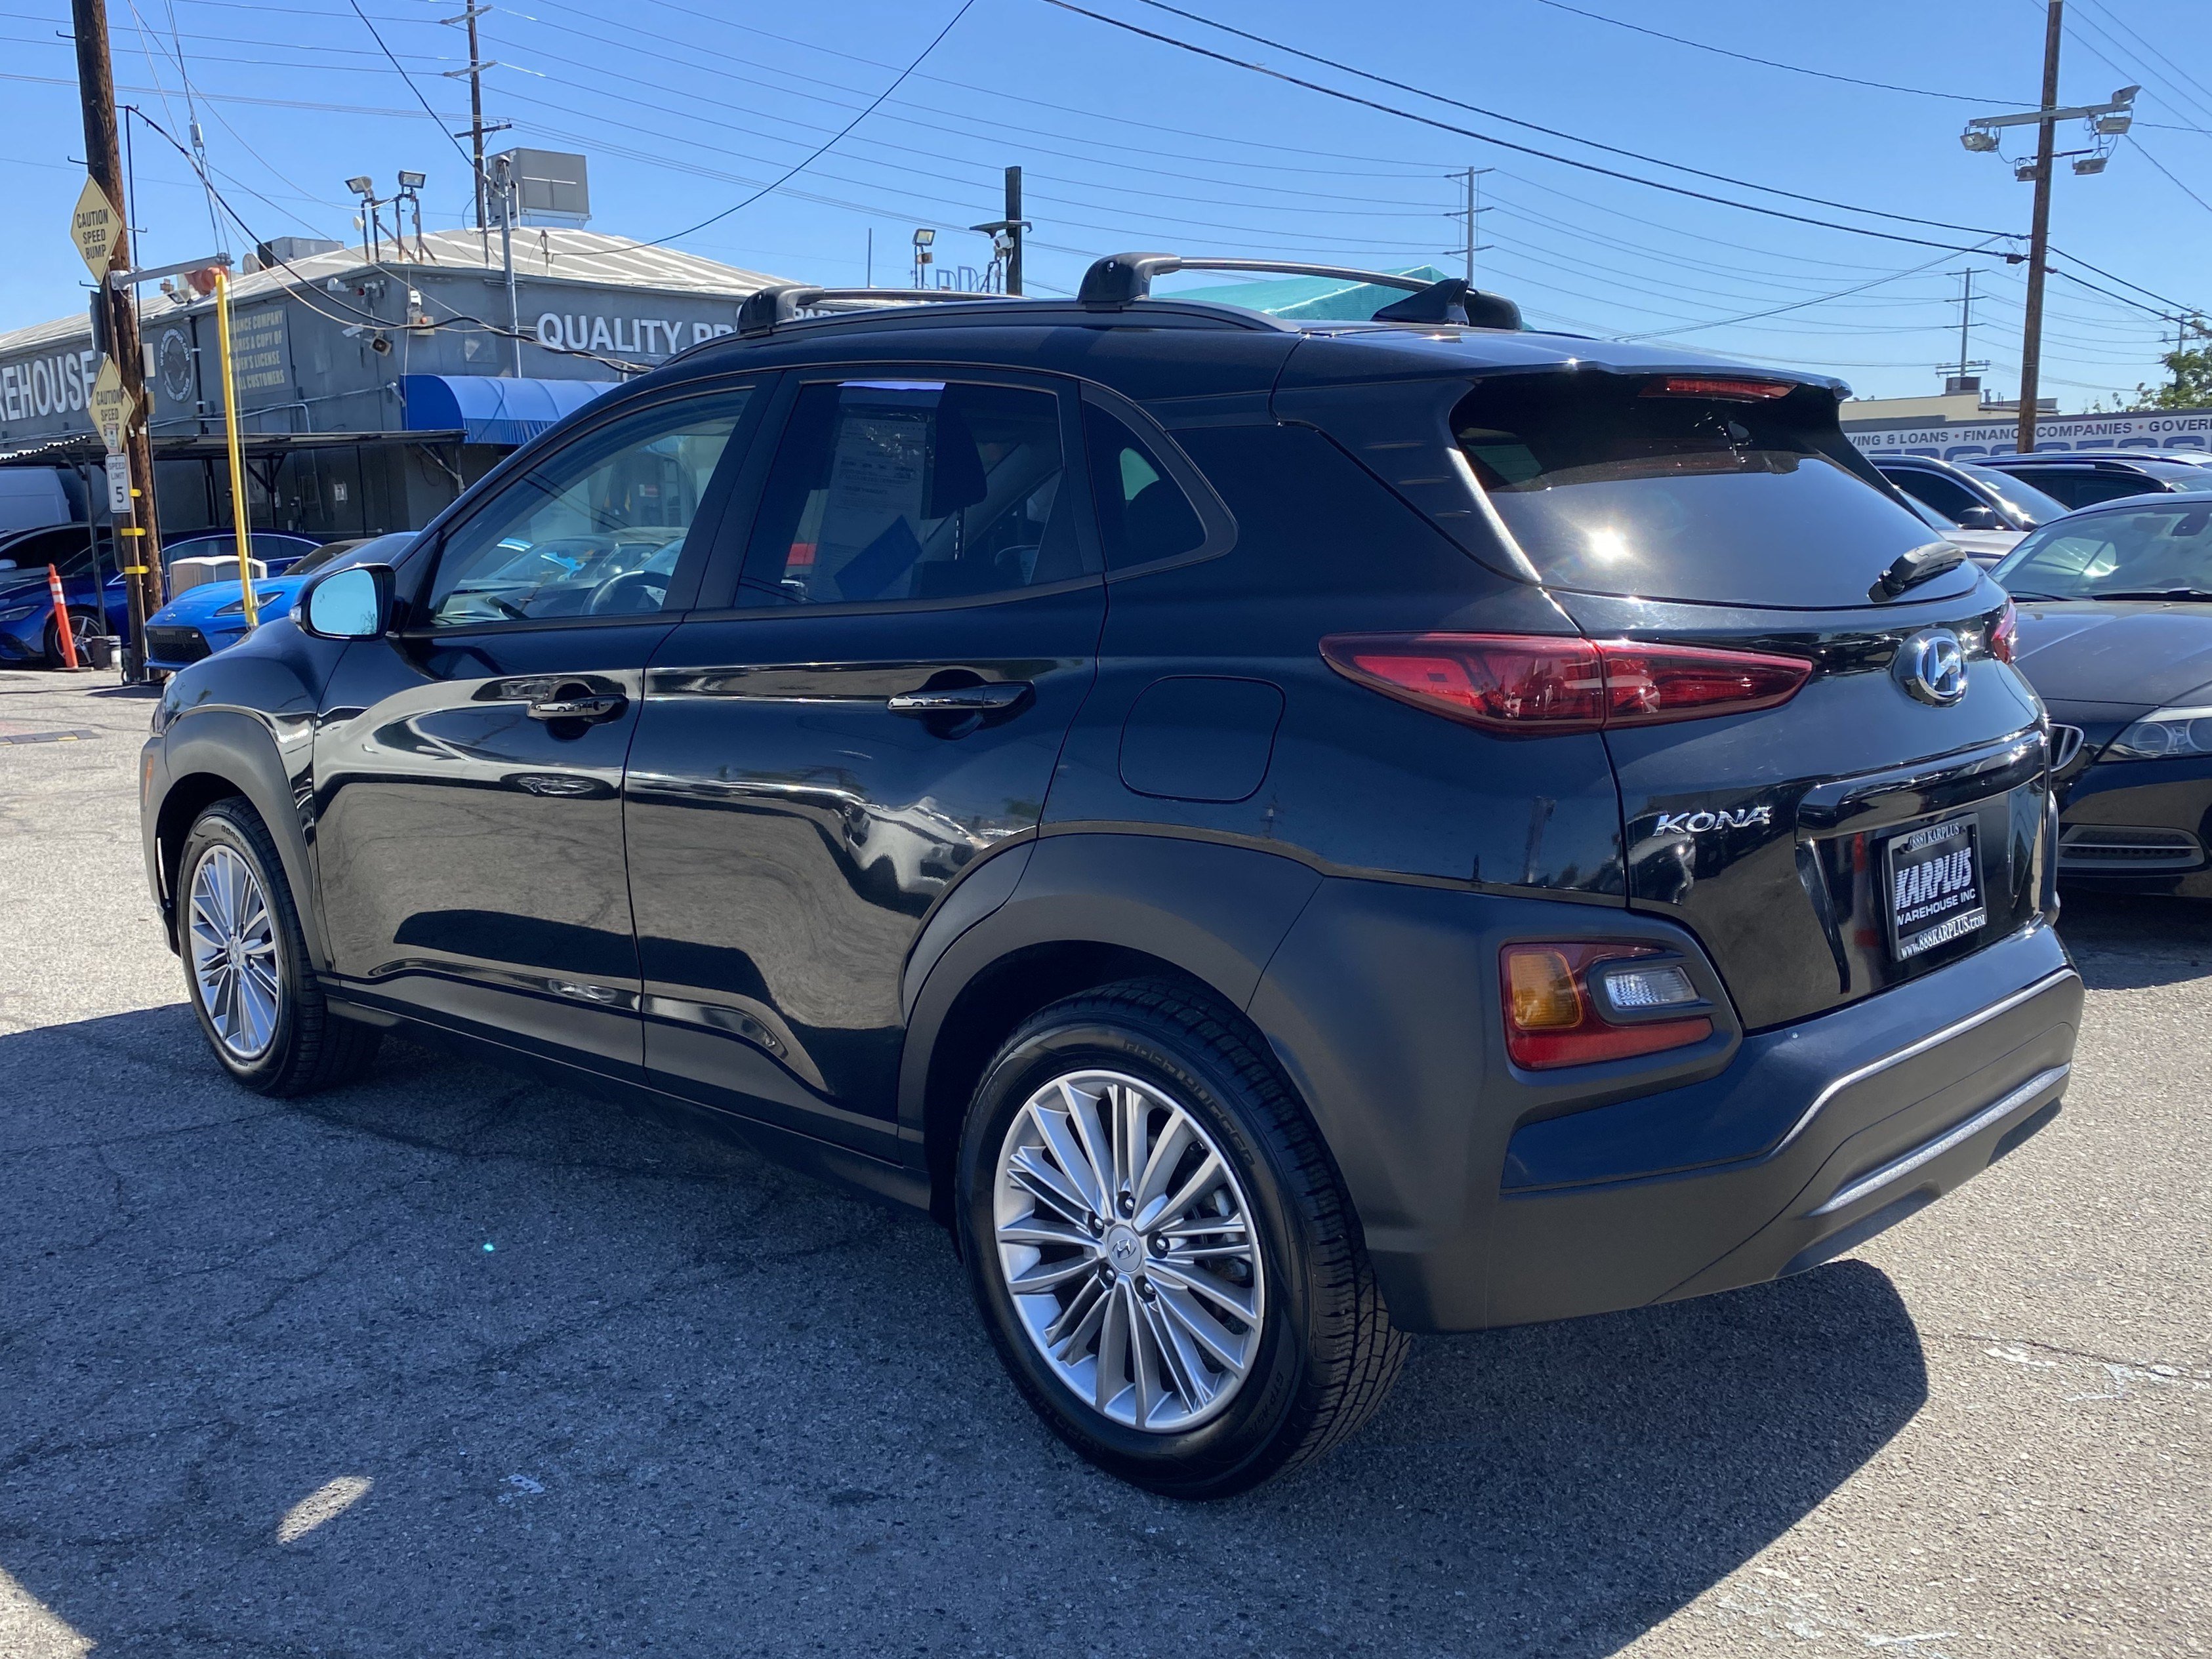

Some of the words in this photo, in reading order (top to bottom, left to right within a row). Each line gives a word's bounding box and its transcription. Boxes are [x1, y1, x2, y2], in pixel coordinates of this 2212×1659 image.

[76, 208, 109, 229] CAUTION
[82, 229, 106, 245] SPEED
[85, 244, 106, 260] BUMP
[253, 310, 283, 329] COMPANY
[251, 336, 256, 350] A
[256, 332, 273, 348] COPY
[274, 330, 282, 345] OF
[254, 350, 281, 368] LICENSE
[247, 369, 285, 389] CUSTOMERS
[96, 389, 121, 406] CAUTION
[101, 408, 119, 422] SPEED
[1887, 434, 1895, 444] &
[1900, 432, 1948, 444] LOANS
[1963, 428, 2019, 441] FINANC
[2036, 422, 2132, 438] COMPANIES
[115, 486, 124, 503] 5
[1652, 806, 1772, 836] KONA
[1927, 823, 1959, 844] KARPLUS
[1895, 847, 1972, 910] KARPLUS
[1896, 895, 1959, 926] WAREHOUSE
[1960, 888, 1976, 903] INC
